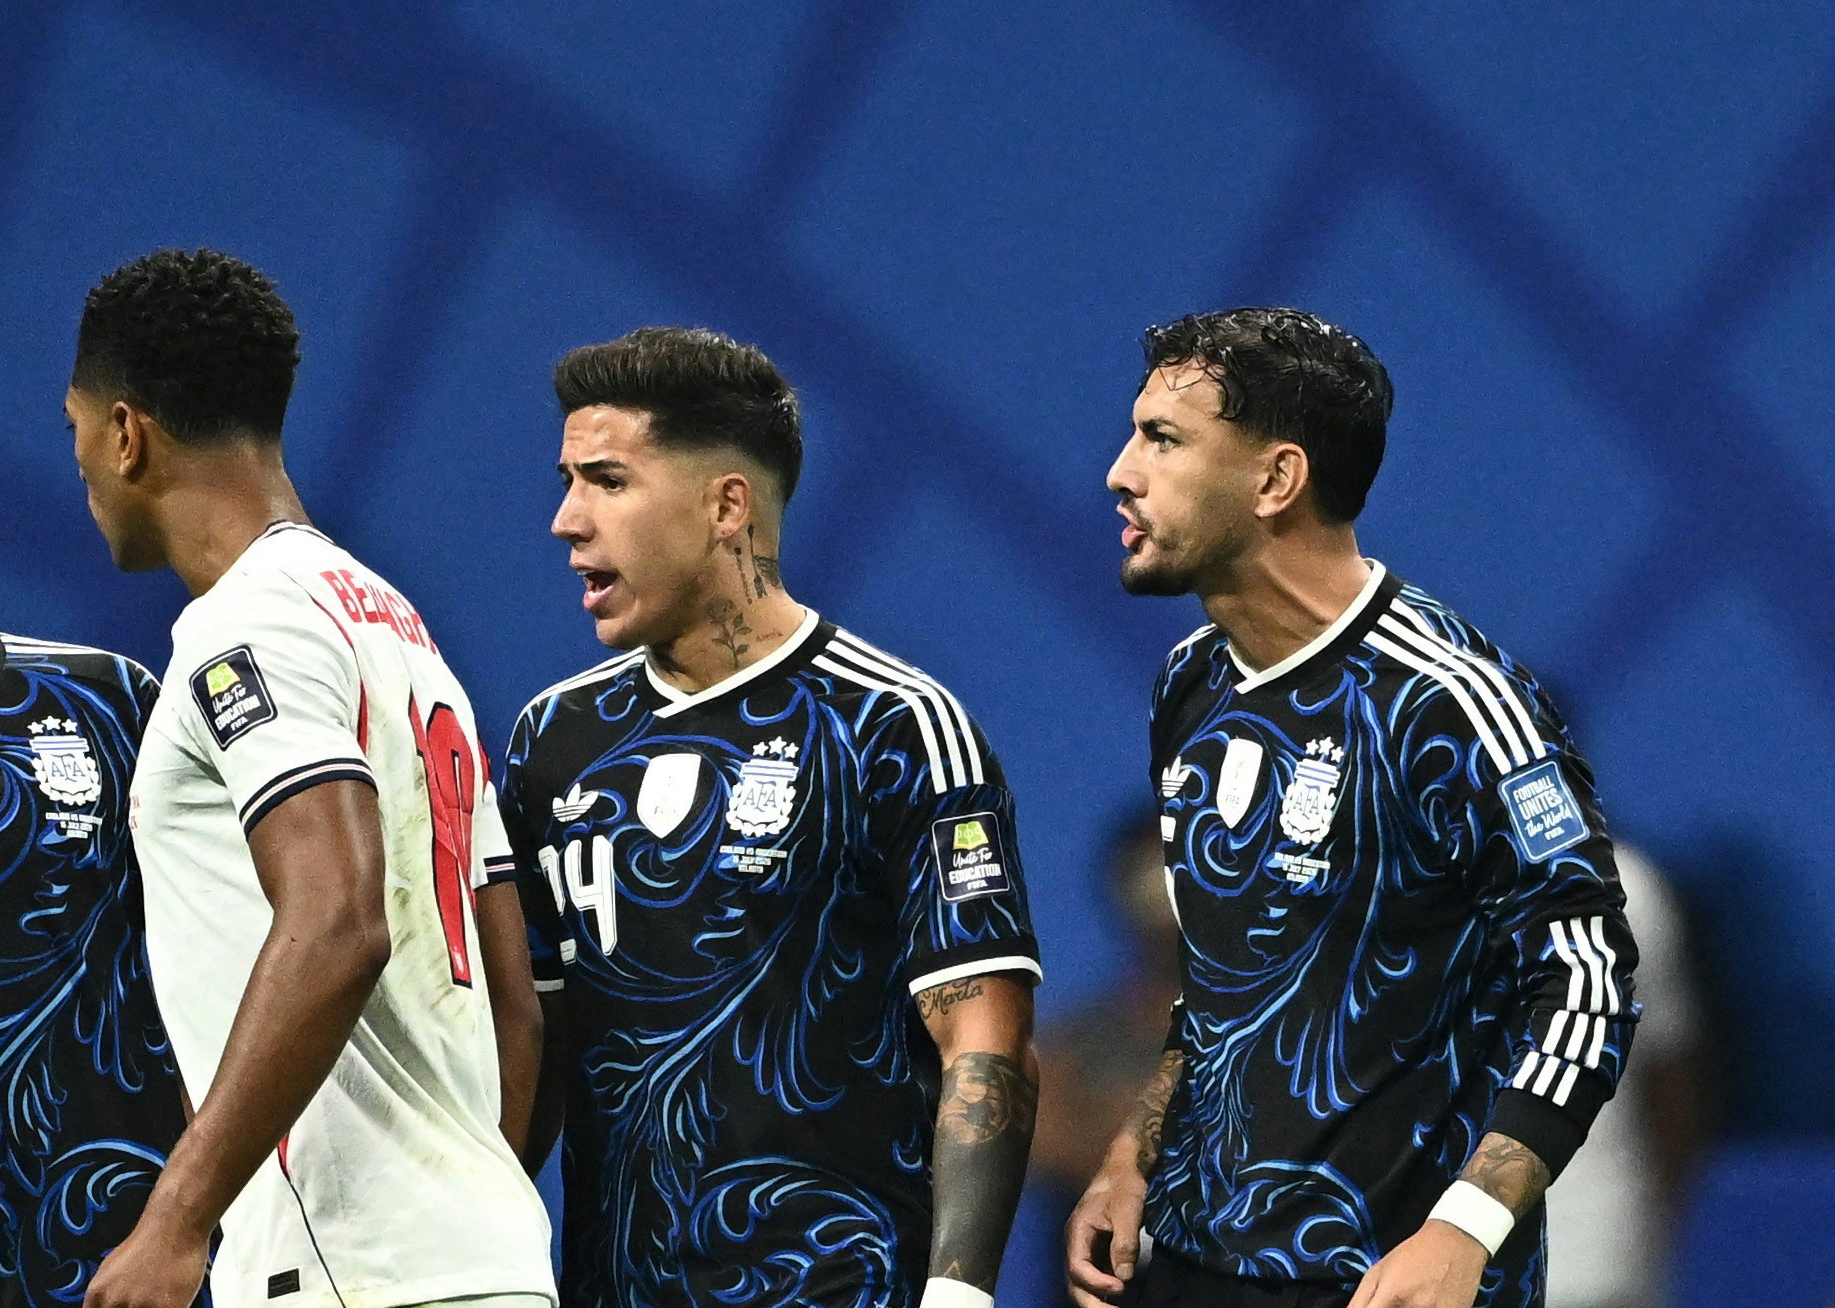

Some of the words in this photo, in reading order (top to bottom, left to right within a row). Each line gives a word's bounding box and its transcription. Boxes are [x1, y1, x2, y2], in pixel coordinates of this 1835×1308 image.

[214, 694, 261, 731] EDUCATION
[230, 716, 248, 731] FIFA
[1512, 774, 1555, 804] FOOTBALL
[1517, 787, 1564, 821] UNITES
[409, 685, 479, 989] 10
[952, 851, 980, 869] Unite
[976, 847, 993, 864] For
[948, 863, 1002, 885] EDUCATION
